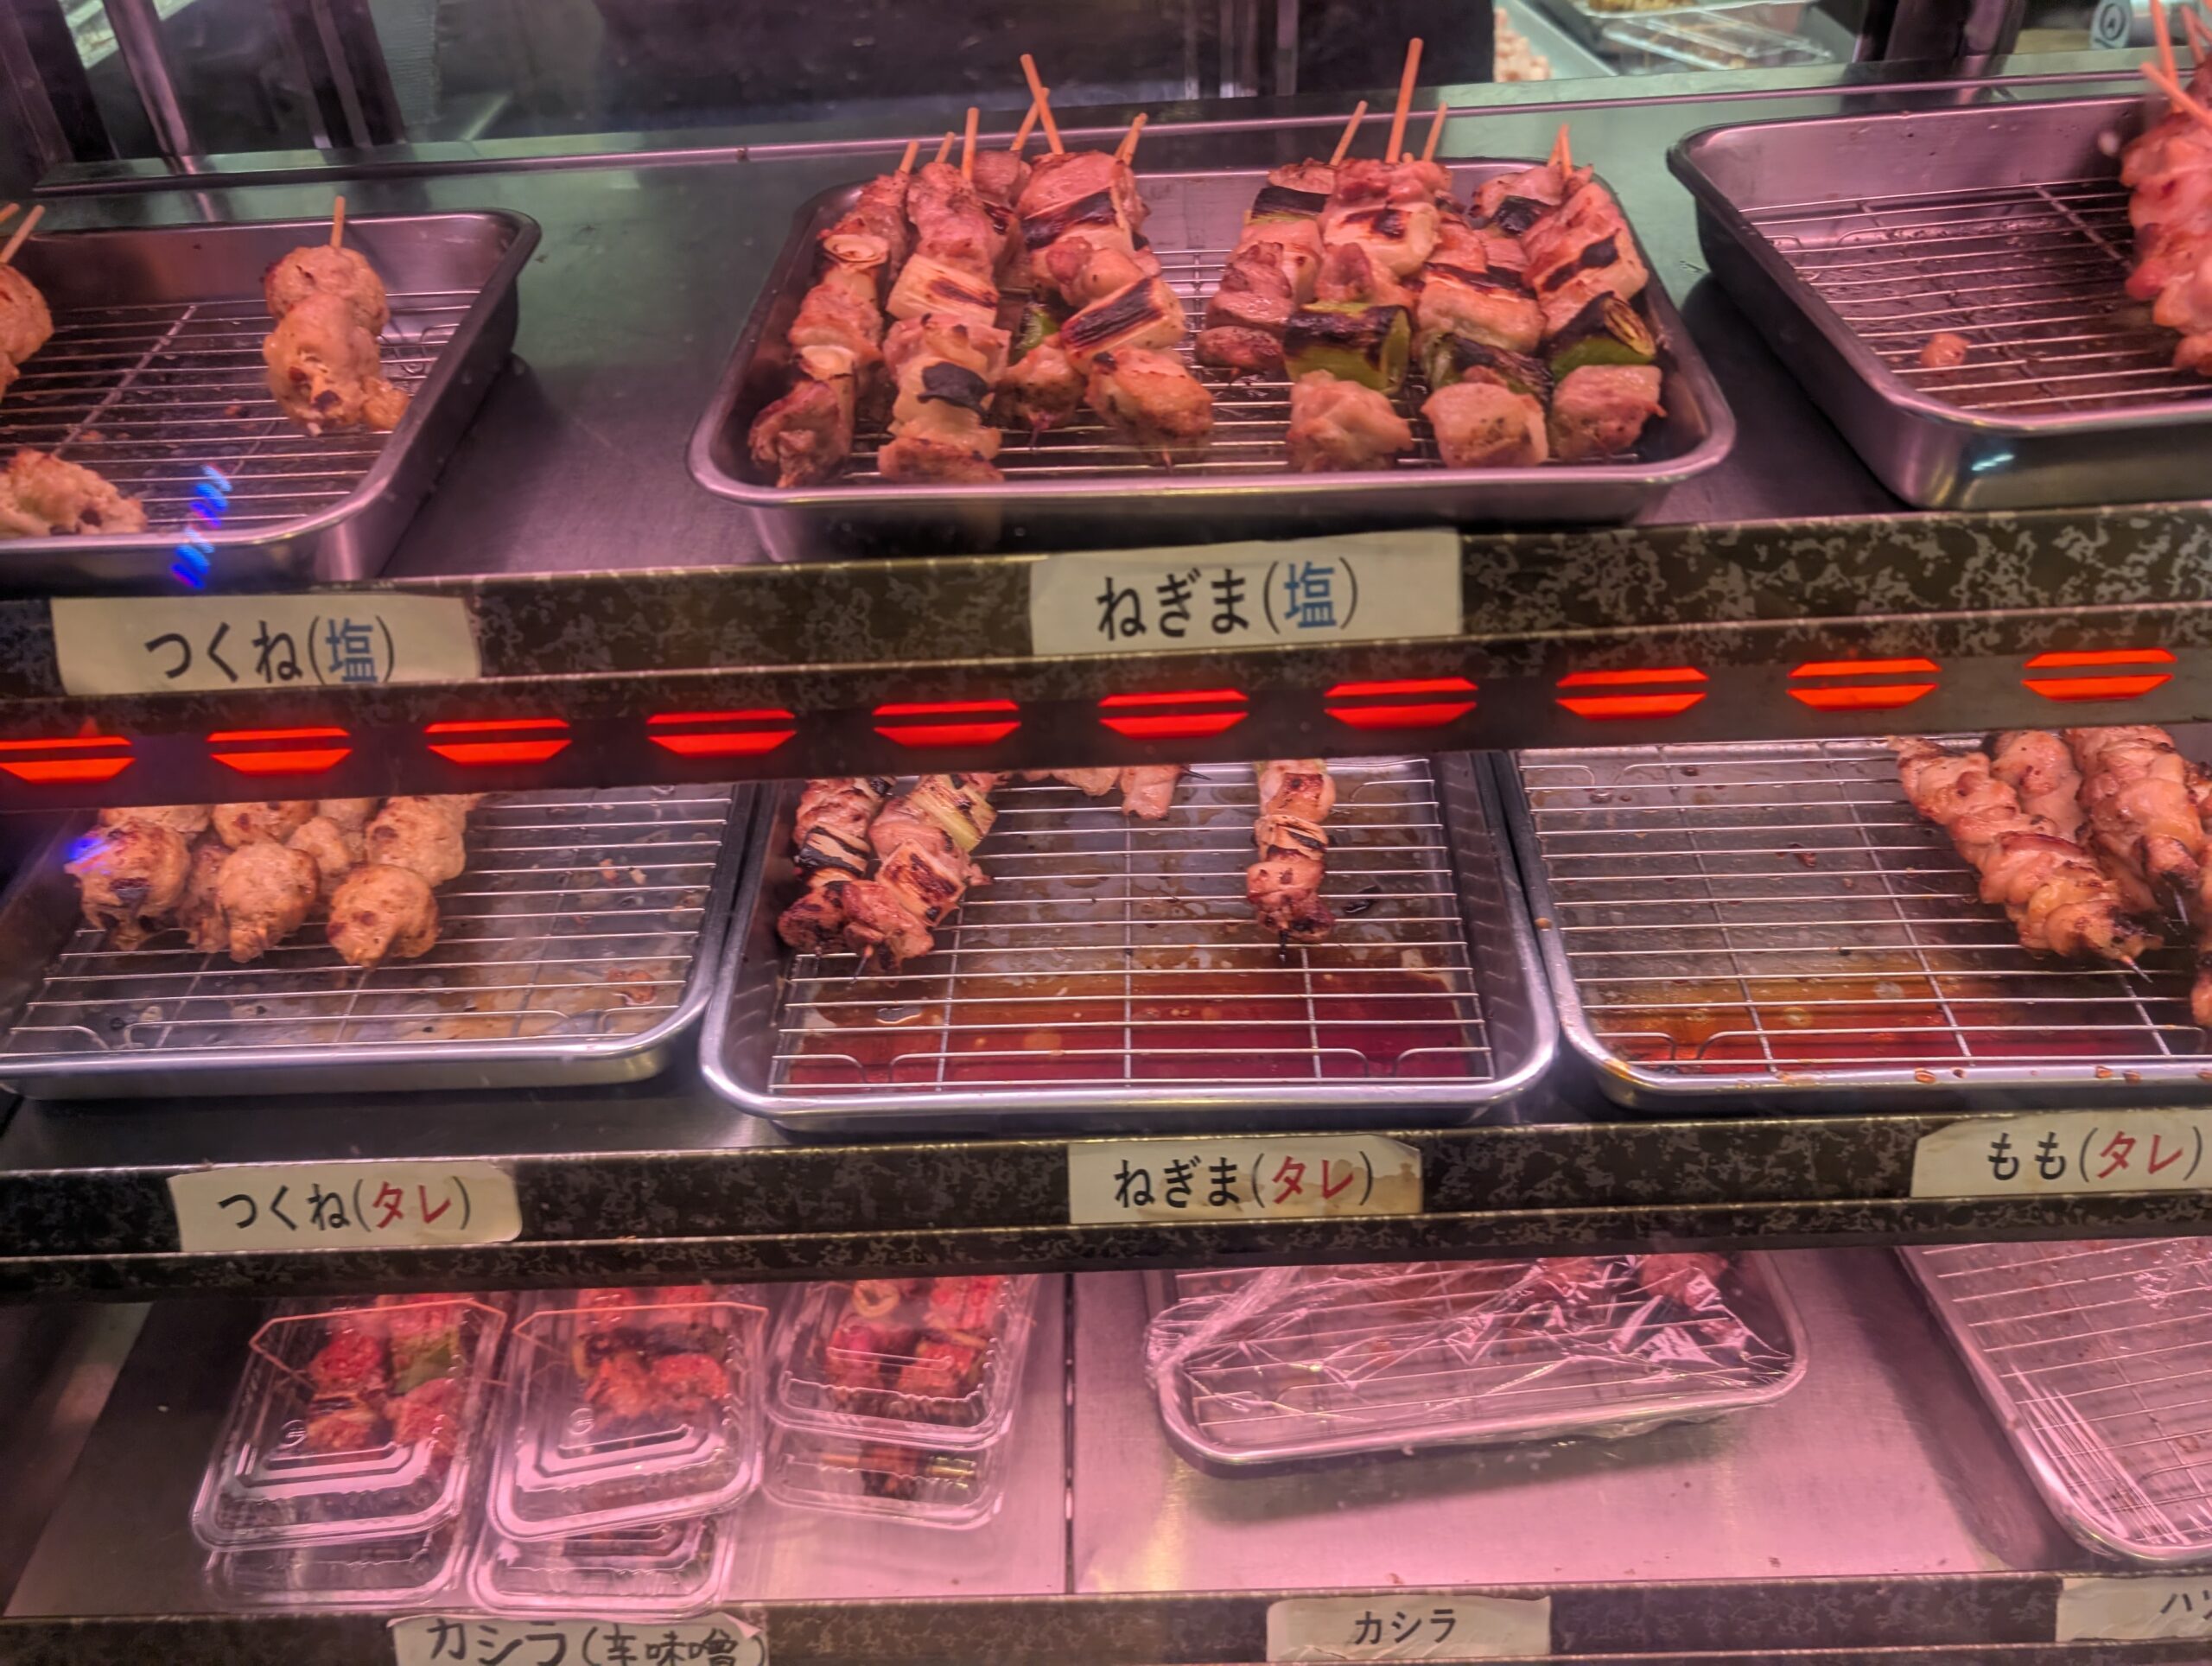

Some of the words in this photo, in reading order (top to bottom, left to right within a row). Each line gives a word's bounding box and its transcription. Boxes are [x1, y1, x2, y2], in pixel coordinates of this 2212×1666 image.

[1096, 556, 1358, 641] ねぎま(塩)
[144, 615, 395, 685] つくね(塩)
[1114, 1151, 1374, 1209] ねぎま(タレ)
[1987, 1126, 2202, 1183] もも(タレ)
[218, 1176, 471, 1233] つくね(タレ)
[1355, 1608, 1457, 1645] カシラ
